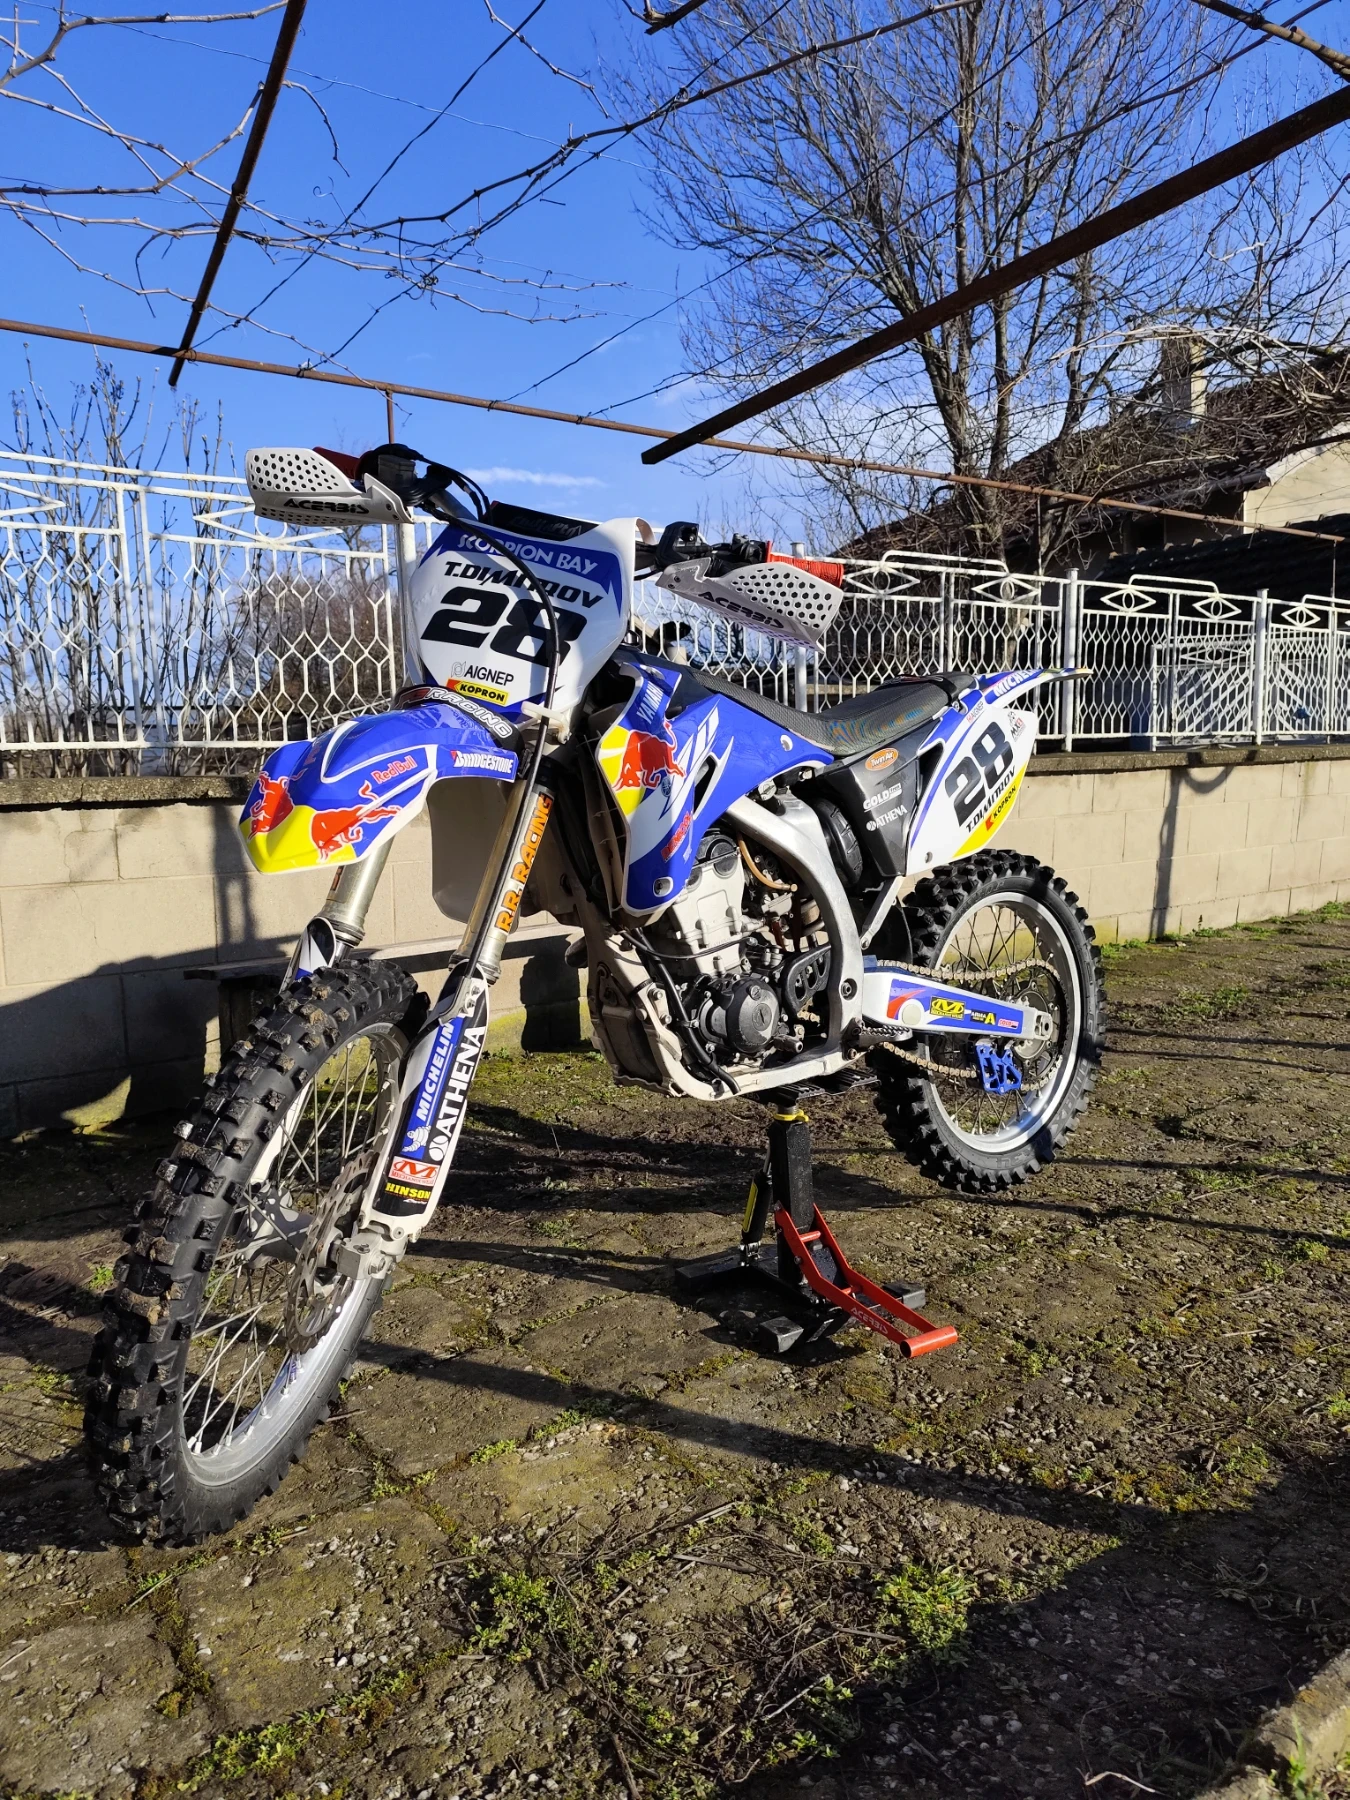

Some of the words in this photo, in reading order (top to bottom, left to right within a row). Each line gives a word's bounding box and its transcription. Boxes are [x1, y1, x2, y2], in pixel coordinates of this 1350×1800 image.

[283, 498, 370, 514] ACERBIS
[556, 552, 599, 575] BAY
[444, 561, 604, 608] T.DIMIROV
[420, 586, 588, 668] 28
[697, 591, 784, 629] ACERBIS
[464, 664, 514, 686] AIGNEP
[459, 683, 506, 702] KOPRON
[425, 688, 513, 738] RACING
[370, 763, 399, 784] Red
[392, 755, 418, 774] Bull
[451, 750, 513, 774] BRIDGESTONE
[945, 721, 1014, 827] 28
[876, 804, 908, 829] ATHENA
[993, 785, 1017, 819] KOPRON
[510, 792, 552, 885] RACING
[416, 1021, 455, 1122] MICHELIN
[436, 1025, 487, 1138] ATHENA
[385, 1182, 431, 1199] HINSON
